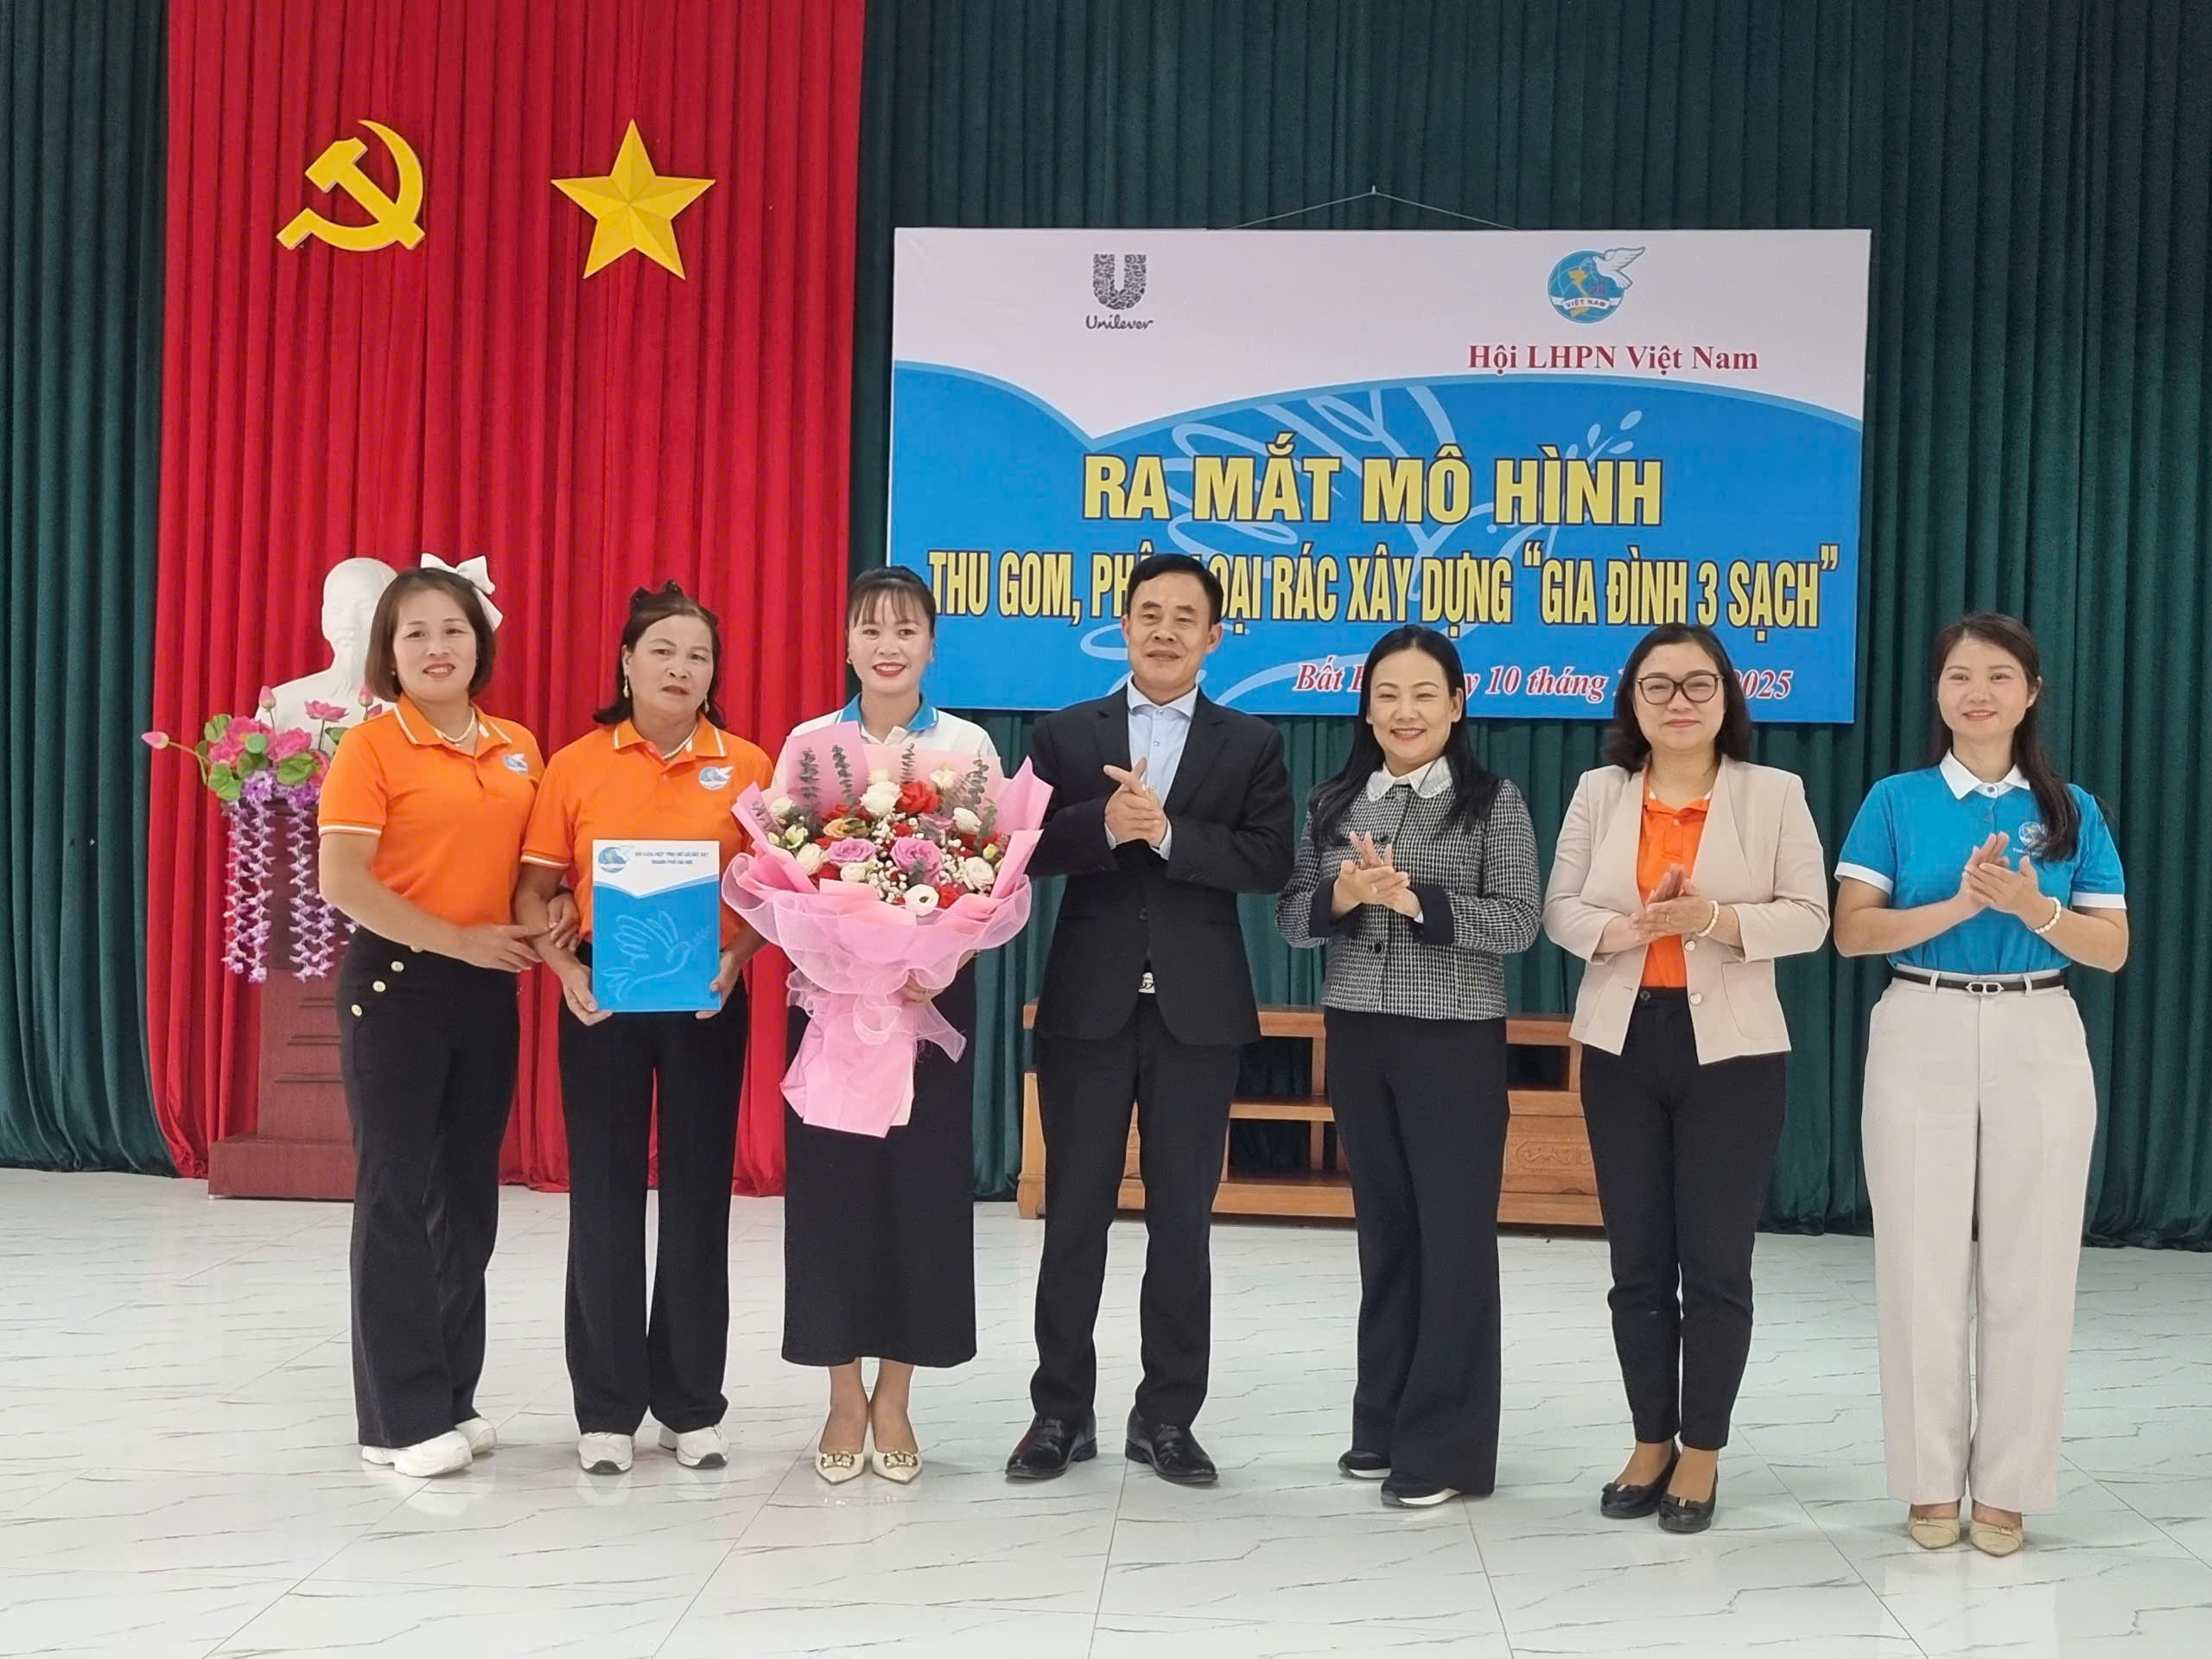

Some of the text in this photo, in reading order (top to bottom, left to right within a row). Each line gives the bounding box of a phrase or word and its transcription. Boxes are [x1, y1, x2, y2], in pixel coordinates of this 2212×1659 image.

[1085, 314, 1154, 329] Unilever
[1469, 345, 1758, 375] Hội LHPN Việt Nam
[1083, 432, 1662, 525] RA MẮT MÔ HÌNH
[929, 550, 991, 616] THU
[998, 550, 1082, 626] GOM,
[1192, 548, 1264, 635] OẠI
[1271, 542, 1338, 621] RÁC
[1345, 542, 1414, 622] XÂY
[1420, 550, 1514, 638] DỰNG
[1605, 544, 1688, 625] ĐÌNH
[1696, 561, 1719, 627] 3
[1293, 655, 1345, 692] Bất
[1485, 664, 1522, 695] 10
[1527, 665, 1609, 703] tháng
